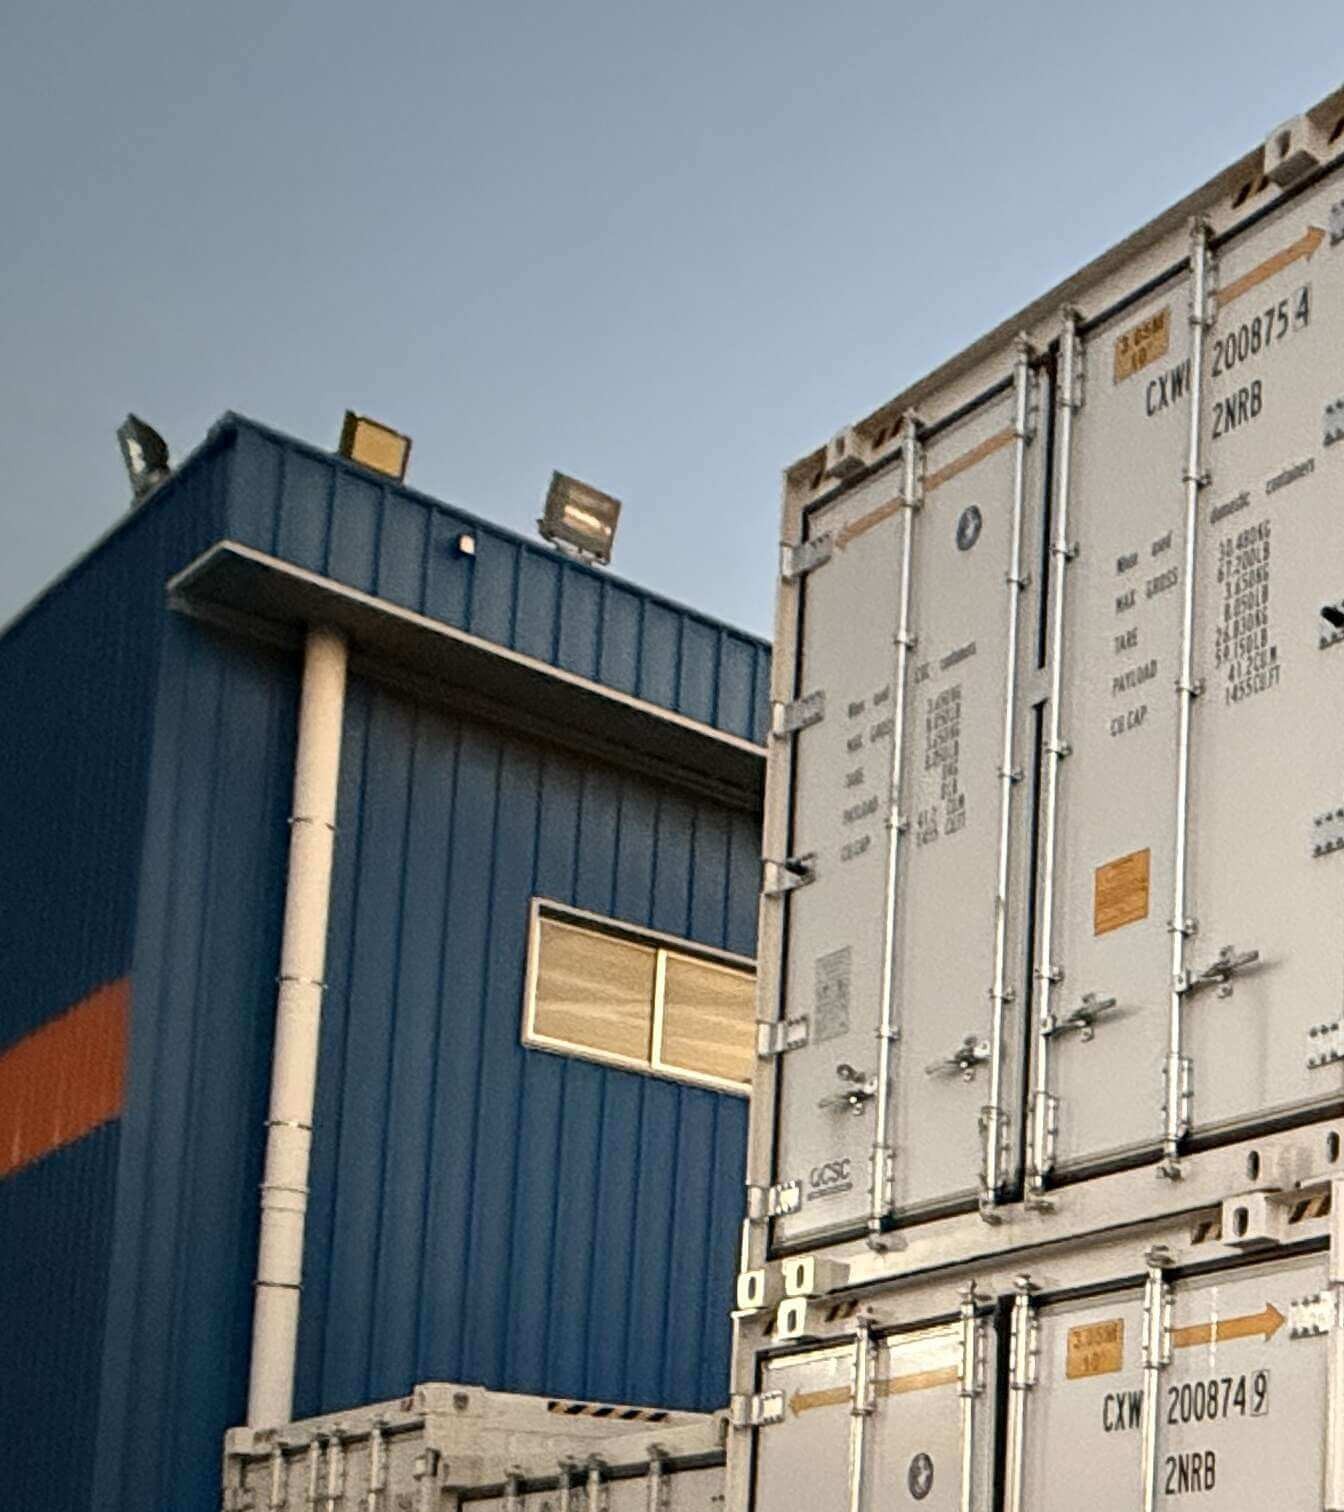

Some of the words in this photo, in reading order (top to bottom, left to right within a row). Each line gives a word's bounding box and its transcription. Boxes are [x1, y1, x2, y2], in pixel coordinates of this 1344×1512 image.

[1212, 298, 1288, 378] 200875
[1212, 379, 1263, 439] 2NRB
[1112, 660, 1158, 697] PAYLOAD
[1166, 1375, 1247, 1426] 200874
[1253, 1371, 1268, 1412] 9
[1165, 1450, 1215, 1495] 2NRB
